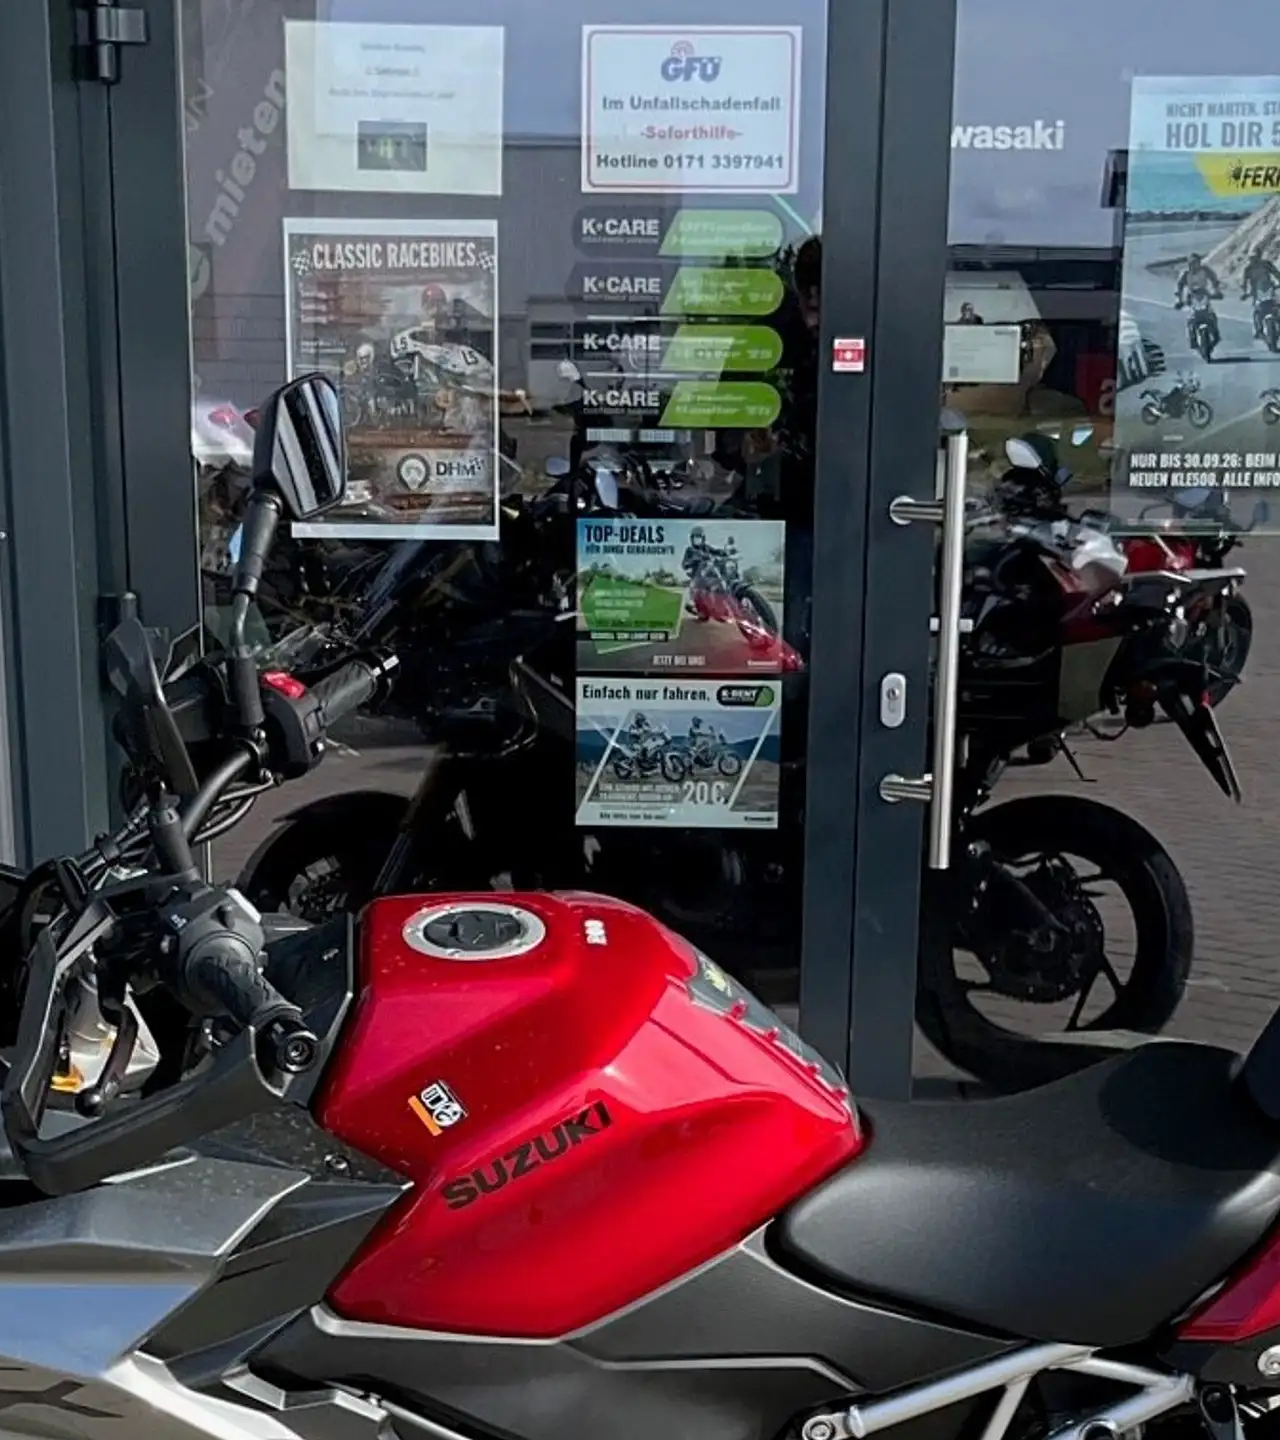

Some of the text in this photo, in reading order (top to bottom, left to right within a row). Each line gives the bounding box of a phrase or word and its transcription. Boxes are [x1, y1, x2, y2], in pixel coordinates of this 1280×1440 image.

[660, 56, 722, 83] GFÜ
[602, 96, 781, 111] Im Unfallschadenfall
[1166, 102, 1203, 117] NICHT
[1166, 121, 1213, 148] HOL
[1221, 121, 1263, 148] DIR
[596, 154, 783, 169] Hotline 0171 3397941
[312, 242, 476, 270] CLASSIC RACEBIKES
[1131, 453, 1157, 468] NUR
[1160, 453, 1181, 468] BIS
[1245, 453, 1276, 468] BEIM
[1129, 472, 1168, 487] NEUEN
[1222, 472, 1251, 487] ALLE
[585, 524, 665, 543] TOP-DEALS
[582, 684, 711, 701] Einfach nur fahren.
[439, 1100, 613, 1211] SUZUKI
